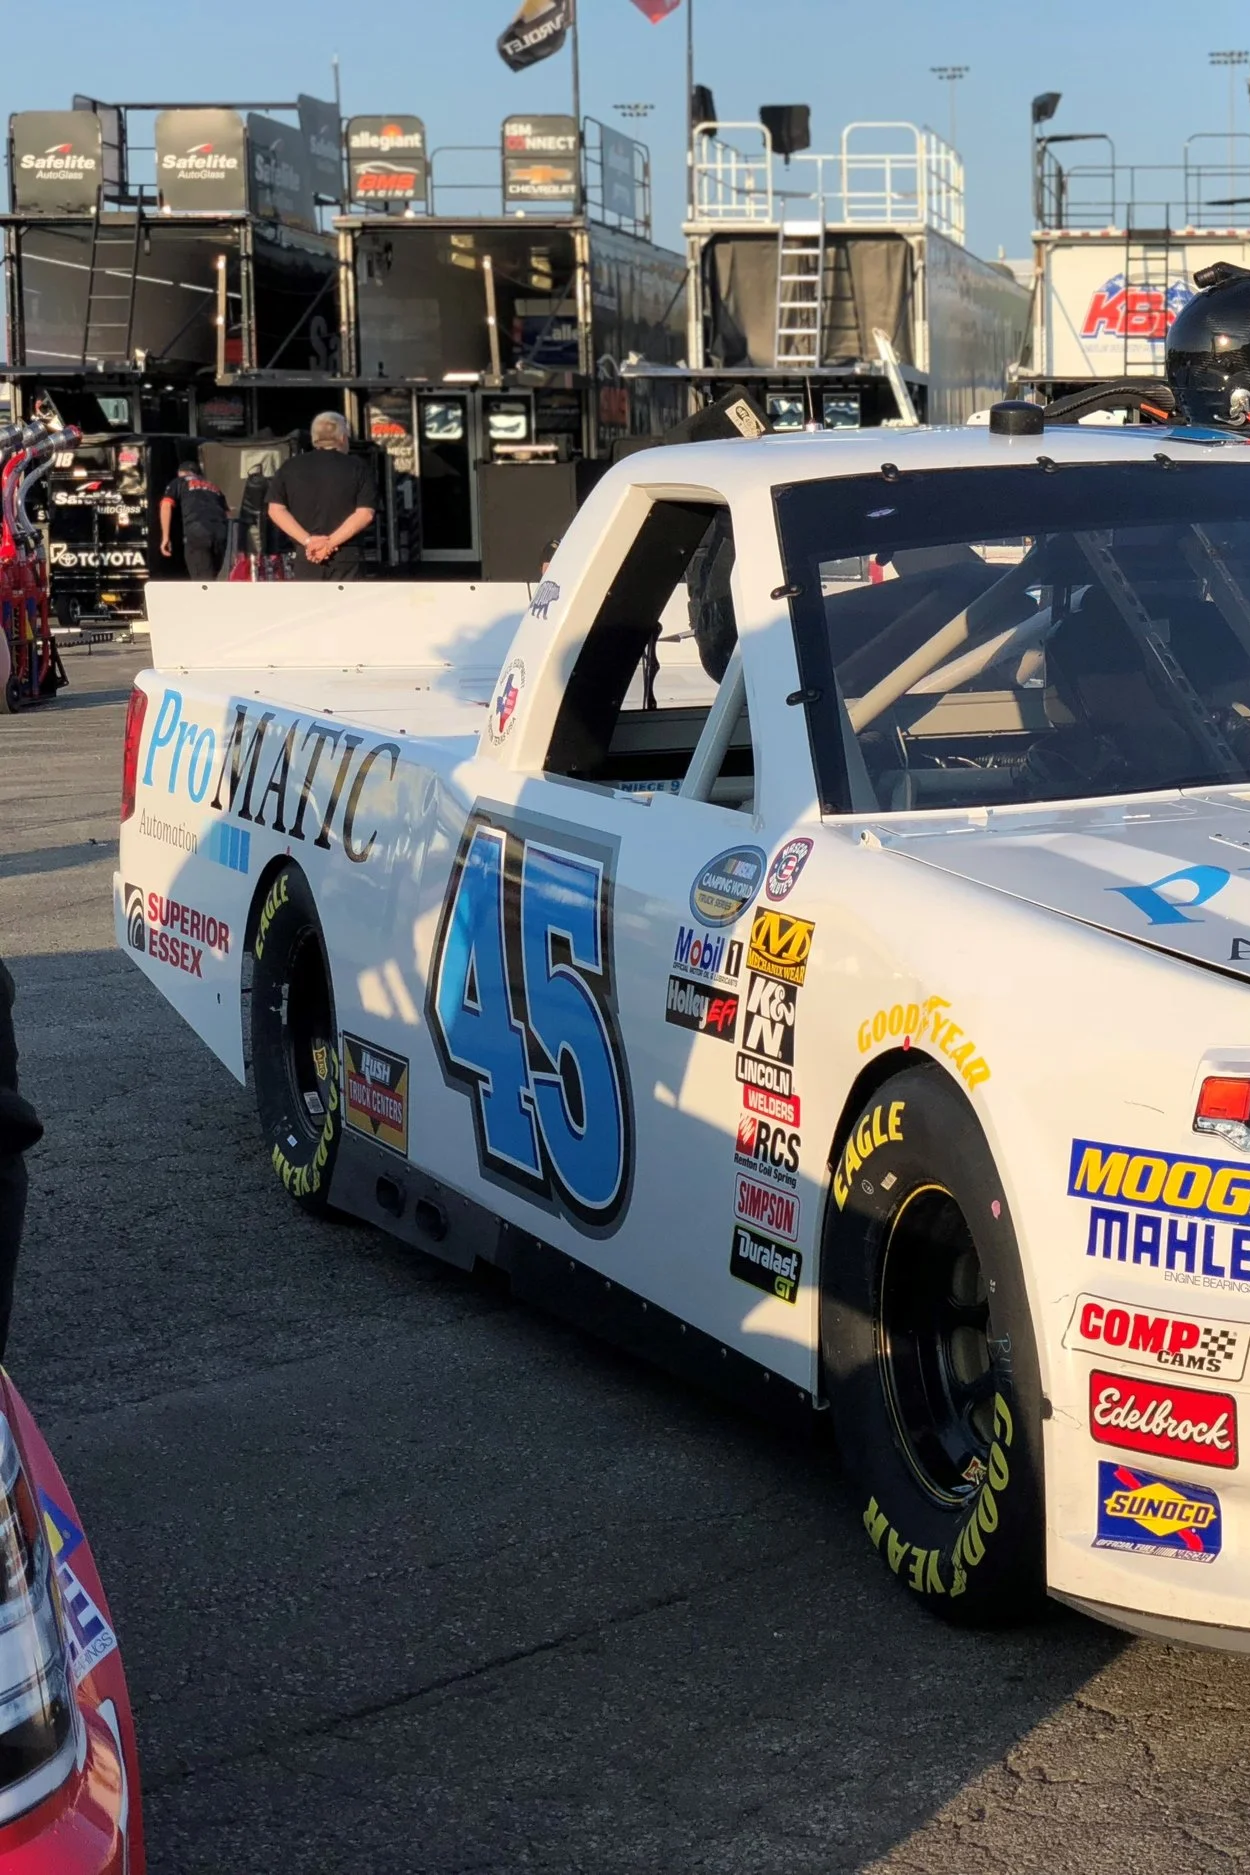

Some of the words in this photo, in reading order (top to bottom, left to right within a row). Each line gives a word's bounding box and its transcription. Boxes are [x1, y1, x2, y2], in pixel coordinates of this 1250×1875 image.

[351, 131, 422, 151] allegiant
[505, 123, 532, 136] ISM
[20, 154, 96, 170] Safelite
[36, 170, 84, 180] AutoGlass
[162, 154, 238, 170] Safelite
[177, 170, 226, 180] AutoGlass
[356, 189, 415, 198] RACING
[509, 184, 576, 194] CHEVROLET
[56, 452, 74, 468] 18
[78, 551, 146, 568] TOYOTA
[142, 688, 403, 864] ProMATIC
[139, 808, 199, 855] Automation
[782, 842, 809, 862] NASCAR
[702, 872, 732, 894] CAMPING
[731, 881, 753, 898] WORLD
[147, 892, 230, 954] SUPERIOR
[255, 875, 289, 961] EAGLE
[149, 930, 203, 979] ESSEX
[674, 926, 726, 974] Mobil
[729, 943, 738, 976] 1
[747, 948, 785, 980] MECHANIX
[784, 964, 806, 984] WEAR
[673, 961, 689, 973] OFFICIAL
[689, 966, 704, 978] MOTOR
[703, 970, 711, 978] OIL
[714, 973, 738, 988] LUBRICANTS
[667, 979, 710, 1030] Holley
[747, 976, 796, 1027] K&
[432, 815, 632, 1225] 45
[746, 1014, 785, 1058] N
[857, 995, 991, 1093] GOODYEAR
[361, 1051, 391, 1085] RUSH
[738, 1056, 790, 1096] LINCOLN
[349, 1078, 371, 1110] TRUCK
[371, 1091, 402, 1124] CENTERS
[748, 1089, 795, 1123] WELDERS
[753, 1119, 801, 1173] RCS
[833, 1101, 905, 1212] EAGLE
[734, 1153, 758, 1171] Renton
[758, 1162, 772, 1177] Coil
[773, 1168, 797, 1190] Spring
[738, 1181, 795, 1234] SIMPSON
[737, 1229, 798, 1281] Duralast
[774, 1276, 795, 1300] GT
[1164, 1270, 1201, 1287] ENGINE
[1079, 1302, 1200, 1355] COMP
[1157, 1350, 1223, 1373] CAMS
[1093, 1387, 1232, 1450] Edelbrock
[862, 1391, 1014, 1598] GOODYEAR
[1111, 1494, 1213, 1525] SUNOCO
[1096, 1539, 1134, 1551] OFFICIAL
[1134, 1543, 1157, 1554] FUEL
[1175, 1549, 1216, 1562] NASCAR
